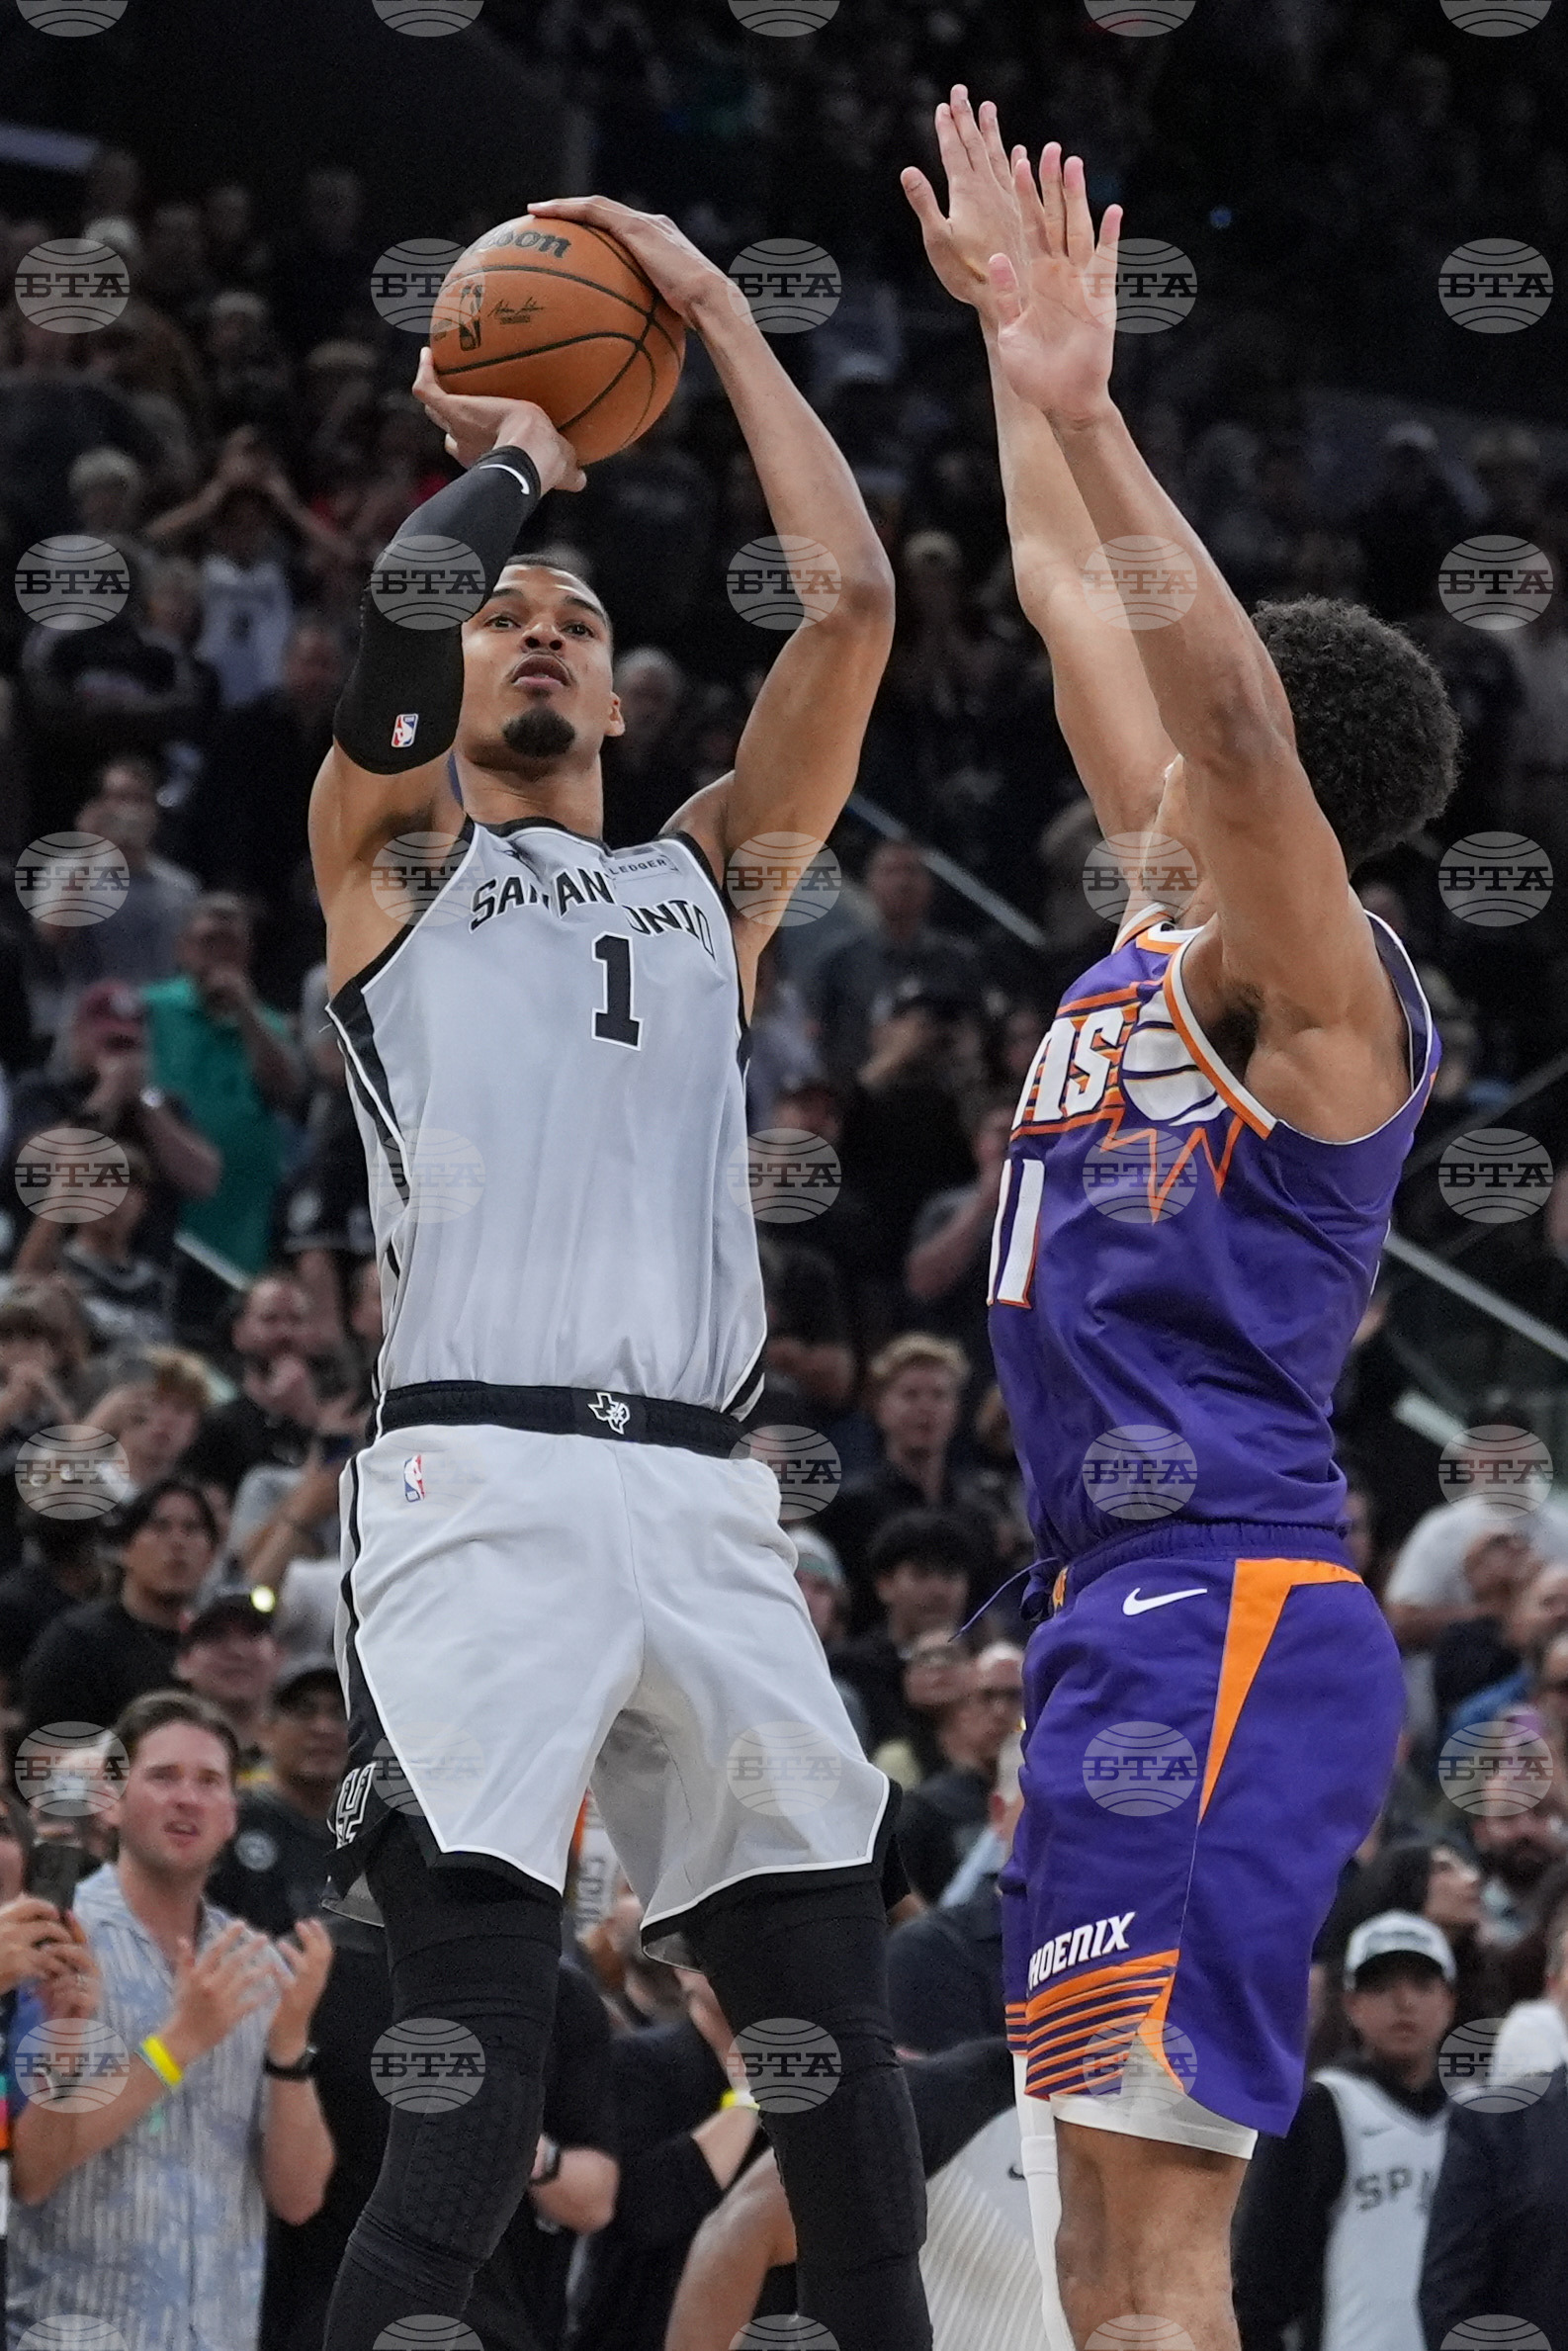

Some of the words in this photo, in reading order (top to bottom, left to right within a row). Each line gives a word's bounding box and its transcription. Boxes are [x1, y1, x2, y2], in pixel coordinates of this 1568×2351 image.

[608, 857, 668, 875] LEDGER
[555, 867, 717, 963] ANONIO
[592, 930, 641, 1051] 1
[1010, 1007, 1125, 1131] NS
[1027, 1911, 1136, 1992] HOENIX
